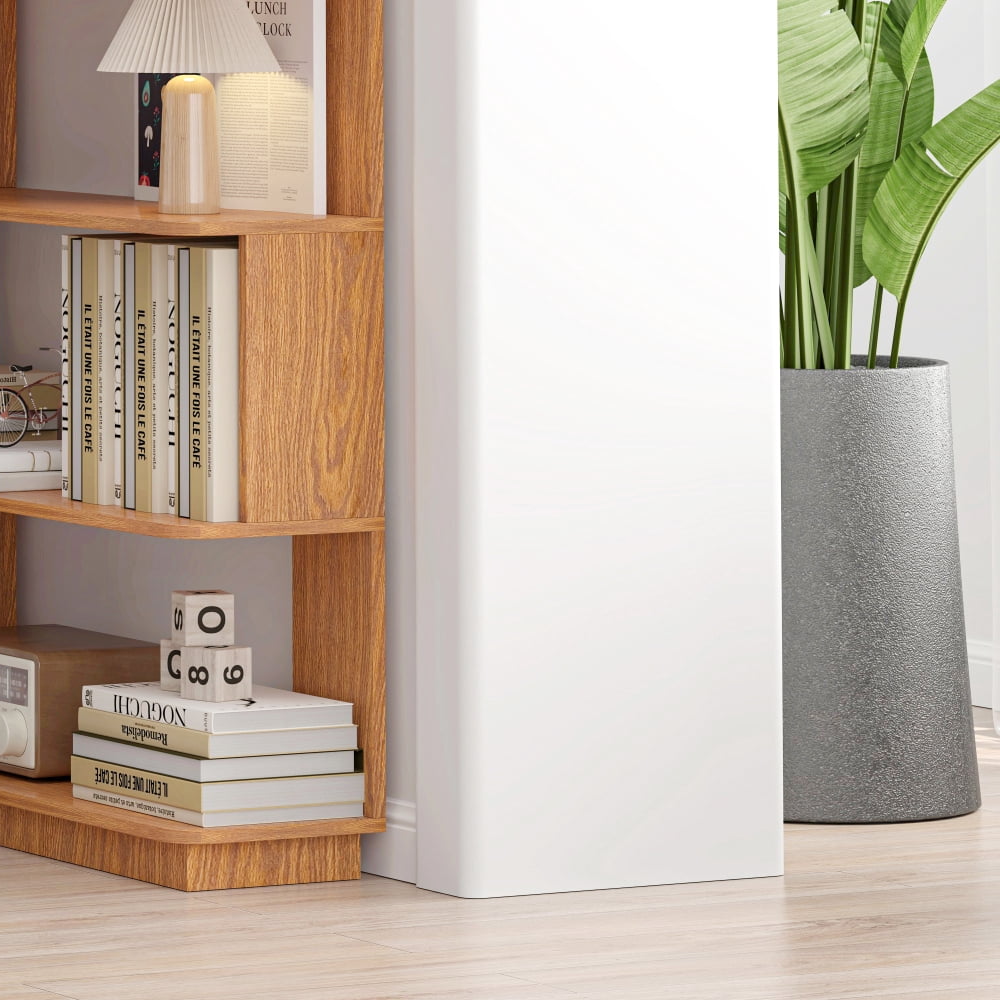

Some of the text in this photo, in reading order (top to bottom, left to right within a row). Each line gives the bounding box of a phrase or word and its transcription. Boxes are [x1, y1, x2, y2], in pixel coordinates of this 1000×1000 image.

[84, 304, 93, 453] IL ÉTAIT UNE FOIS LE CAFÉ
[137, 310, 147, 461] IL ÉTAIT UNE FOIS LE CAFÉ
[192, 316, 202, 469] IL ÉTAIT UNE FOIS LE CAFÉ
[188, 666, 209, 685] 8
[113, 694, 186, 727] NOGUCHI
[121, 724, 168, 746] Remodelista
[94, 767, 168, 799] IL ÉTAIT UNE FOIS LE CAFÉ
